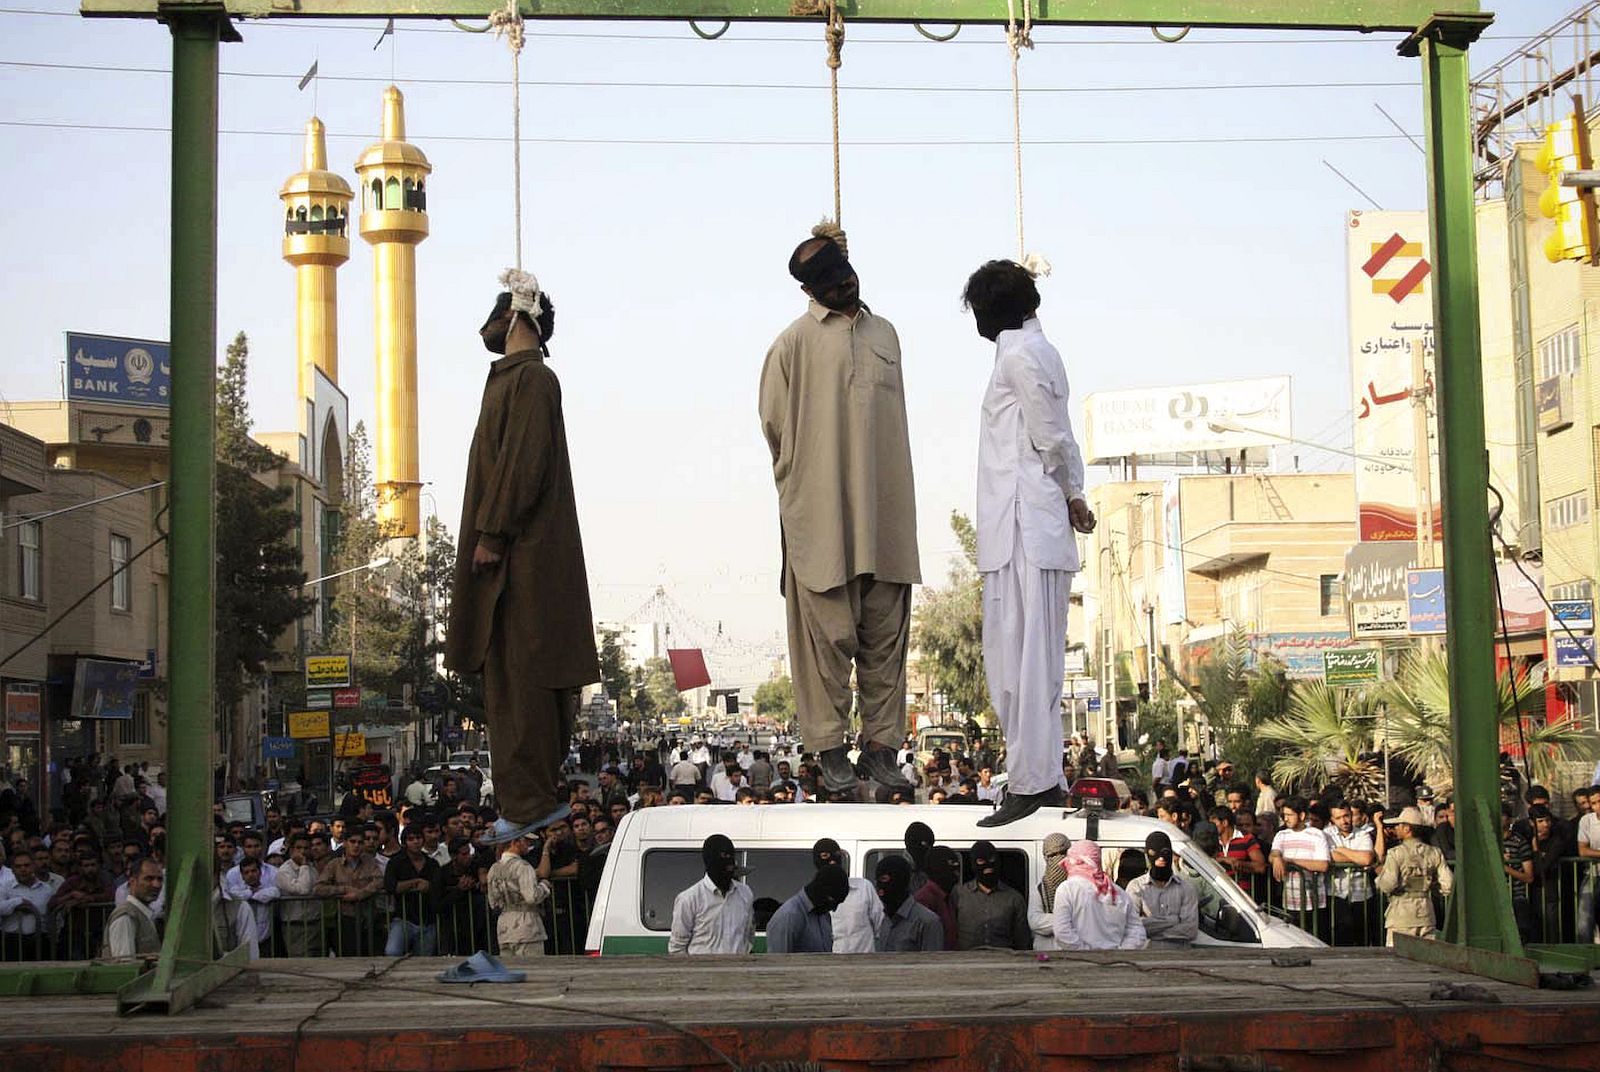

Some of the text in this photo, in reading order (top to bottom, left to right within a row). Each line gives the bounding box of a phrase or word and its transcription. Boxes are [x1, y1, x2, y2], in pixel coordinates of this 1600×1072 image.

[75, 347, 117, 375] سپه
[74, 378, 119, 393] BANK
[1104, 418, 1153, 436] BANK
